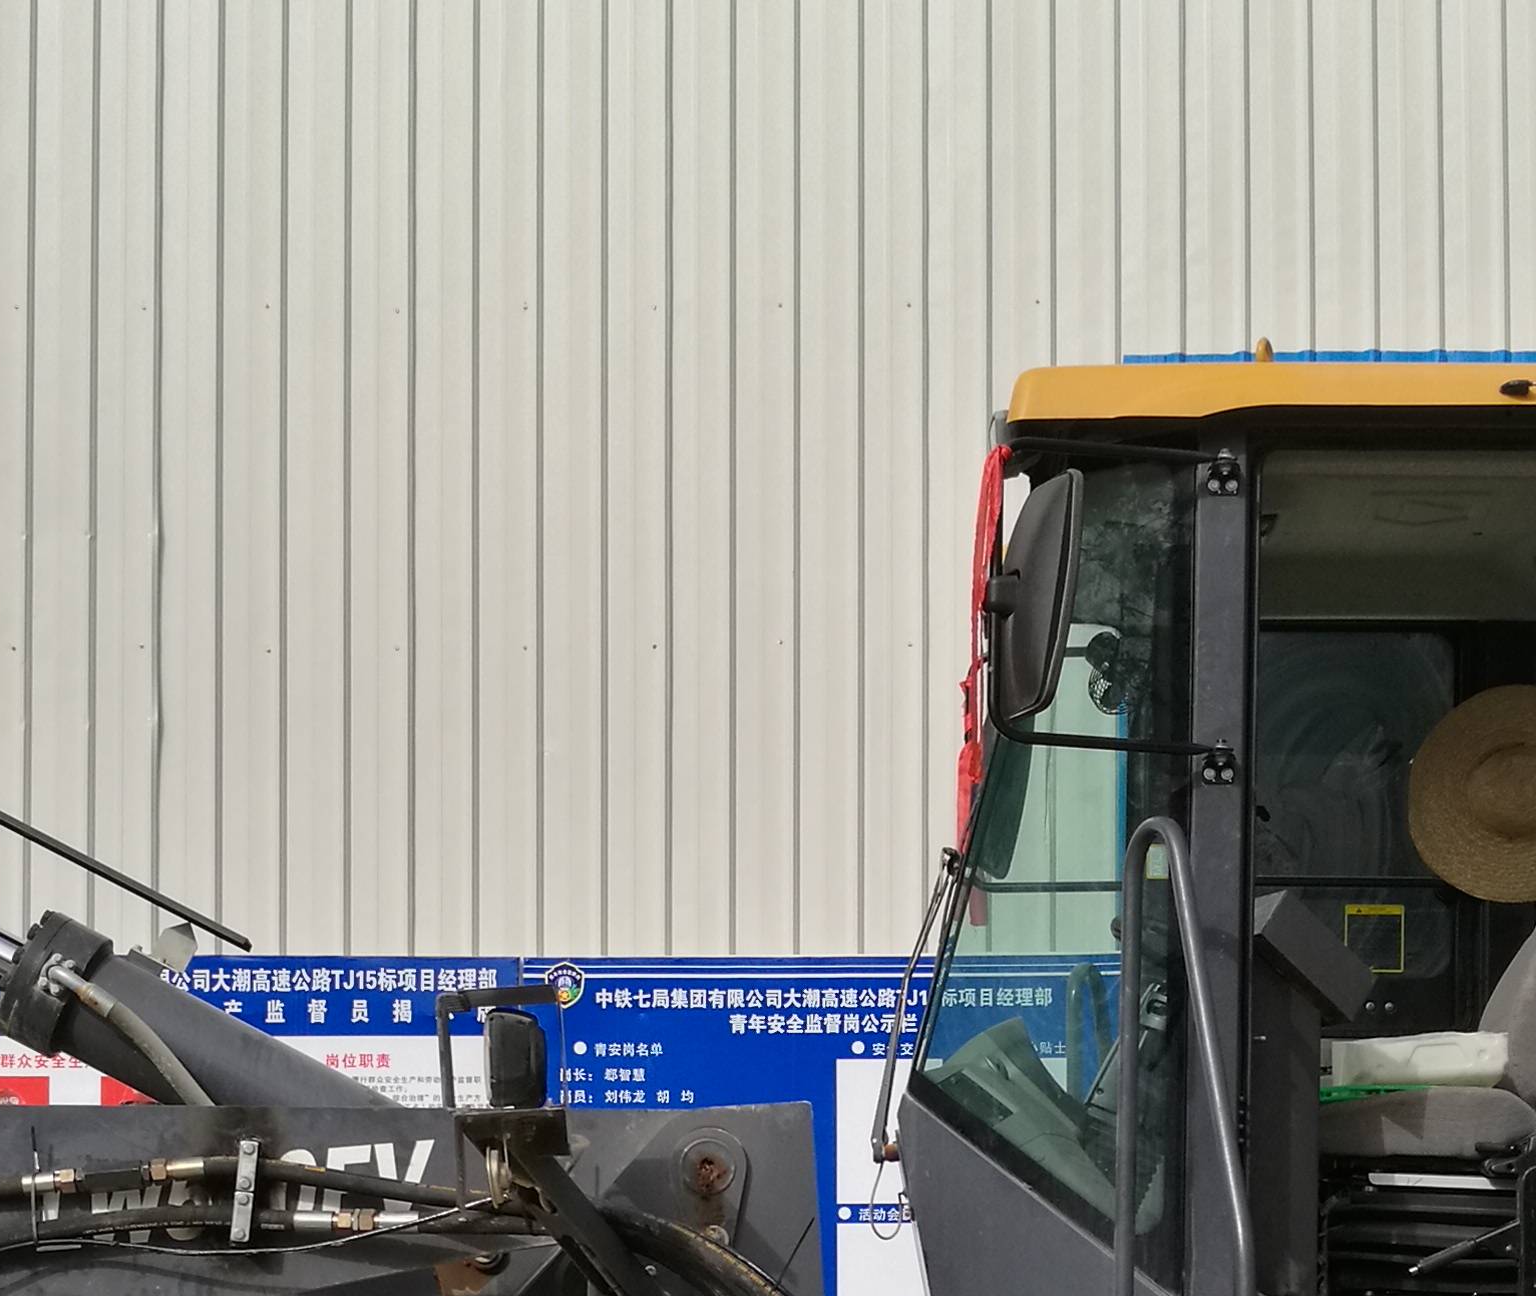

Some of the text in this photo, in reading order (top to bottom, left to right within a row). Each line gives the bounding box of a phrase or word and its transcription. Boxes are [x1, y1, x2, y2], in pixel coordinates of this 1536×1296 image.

[595, 987, 1053, 1009] 中铁七局集团有限公司大潮高速公路J1标项目经理部
[729, 1014, 918, 1034] 青年安全监督岗公示栏
[593, 1043, 663, 1057] 青安岗名单
[1031, 1040, 1067, 1055] 贴士
[0, 1054, 89, 1069] 群众安全生
[326, 1053, 391, 1069] 岗位职责
